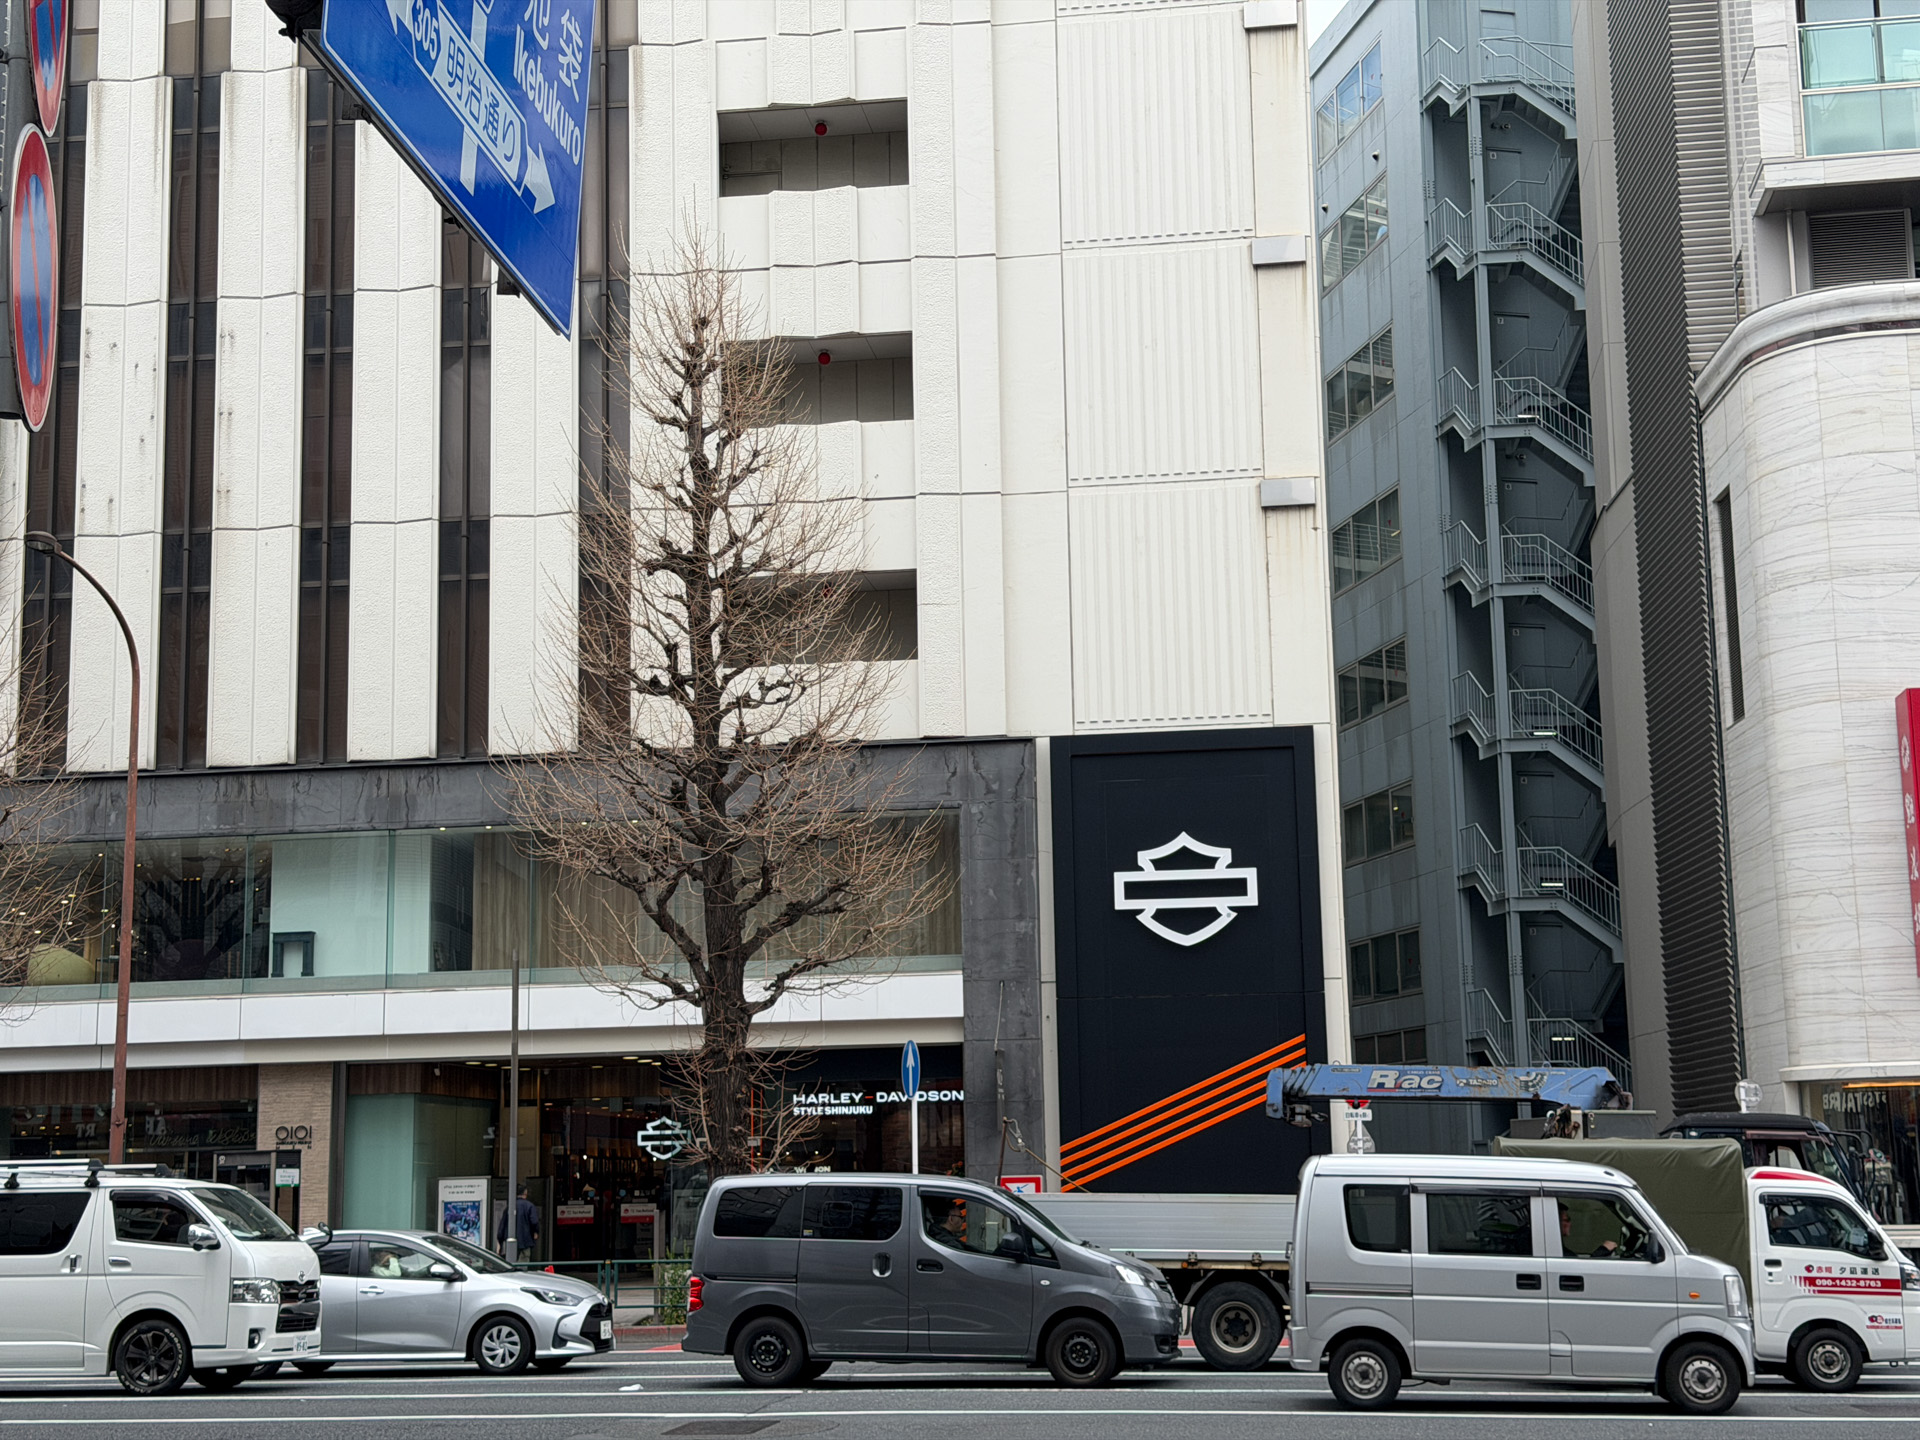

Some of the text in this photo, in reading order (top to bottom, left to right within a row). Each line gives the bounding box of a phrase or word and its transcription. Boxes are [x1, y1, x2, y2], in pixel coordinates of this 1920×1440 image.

[415, 0, 439, 61] 305
[447, 35, 515, 163] 明治通り
[513, 23, 581, 166] Ikebukuro
[793, 1090, 965, 1104] HARLEY-DAVDSON
[793, 1105, 873, 1116] STYLE SHINJUKU
